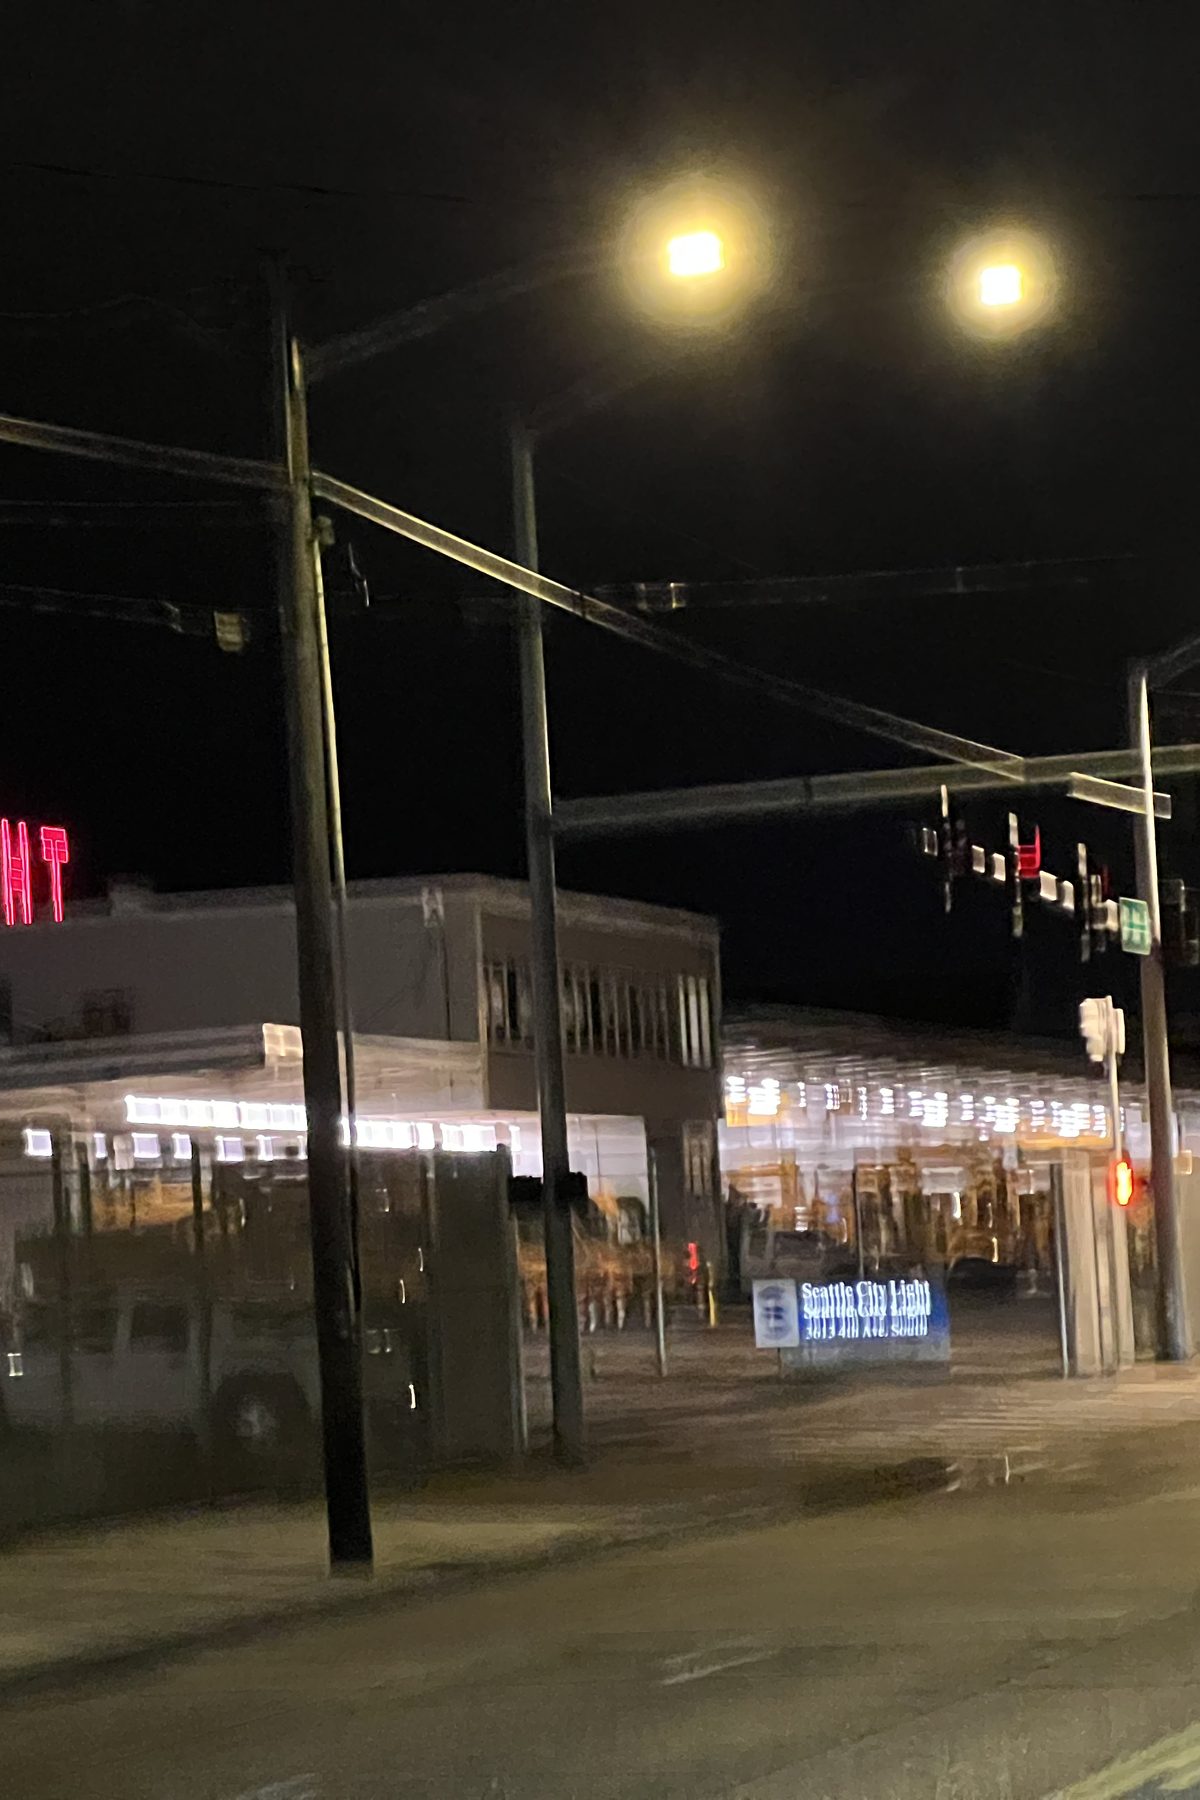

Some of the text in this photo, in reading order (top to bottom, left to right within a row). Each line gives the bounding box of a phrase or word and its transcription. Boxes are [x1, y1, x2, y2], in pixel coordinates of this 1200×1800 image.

[802, 1279, 932, 1316] Seattle City Light
